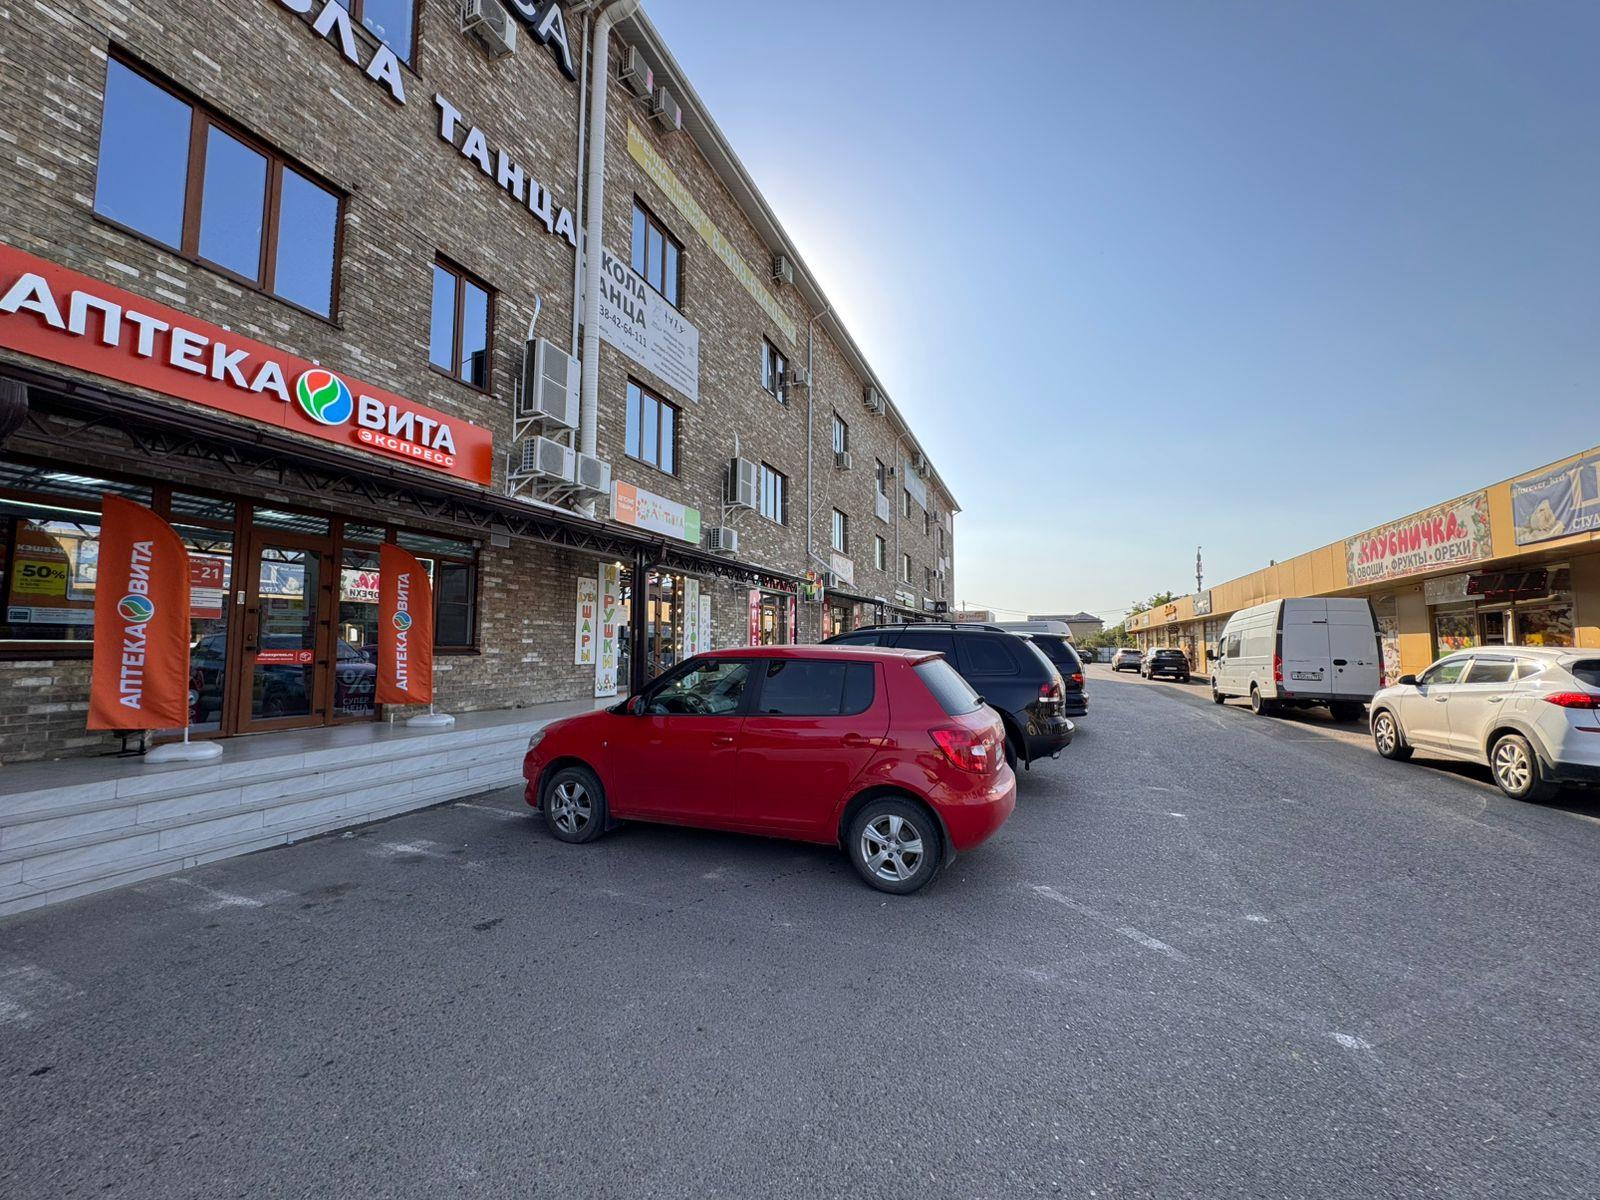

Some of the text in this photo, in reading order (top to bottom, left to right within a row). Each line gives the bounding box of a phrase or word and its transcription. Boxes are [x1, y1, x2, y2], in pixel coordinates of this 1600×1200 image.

[435, 93, 577, 248] ТАНЦА
[600, 250, 648, 306] КОЛА
[600, 276, 647, 330] АНЦА
[600, 303, 648, 348] 38-42-64-111
[1, 272, 456, 455] АПТЕКА ВИТА
[361, 431, 454, 466] ЭКСПРЕСС
[1357, 563, 1384, 578] ОВОЩИ
[1391, 550, 1428, 571] ФРУКТЫ
[1434, 539, 1472, 561] ОРЕХИ
[1358, 511, 1458, 565] КЛУБНИЧКА
[128, 540, 154, 595] ВИТА
[397, 572, 411, 612] ВИТА
[581, 605, 592, 662] ШАРЫ
[603, 565, 617, 669] ИГРУШКИ
[119, 623, 147, 710] АПТЕКА
[395, 630, 409, 692] АПТЕКА
